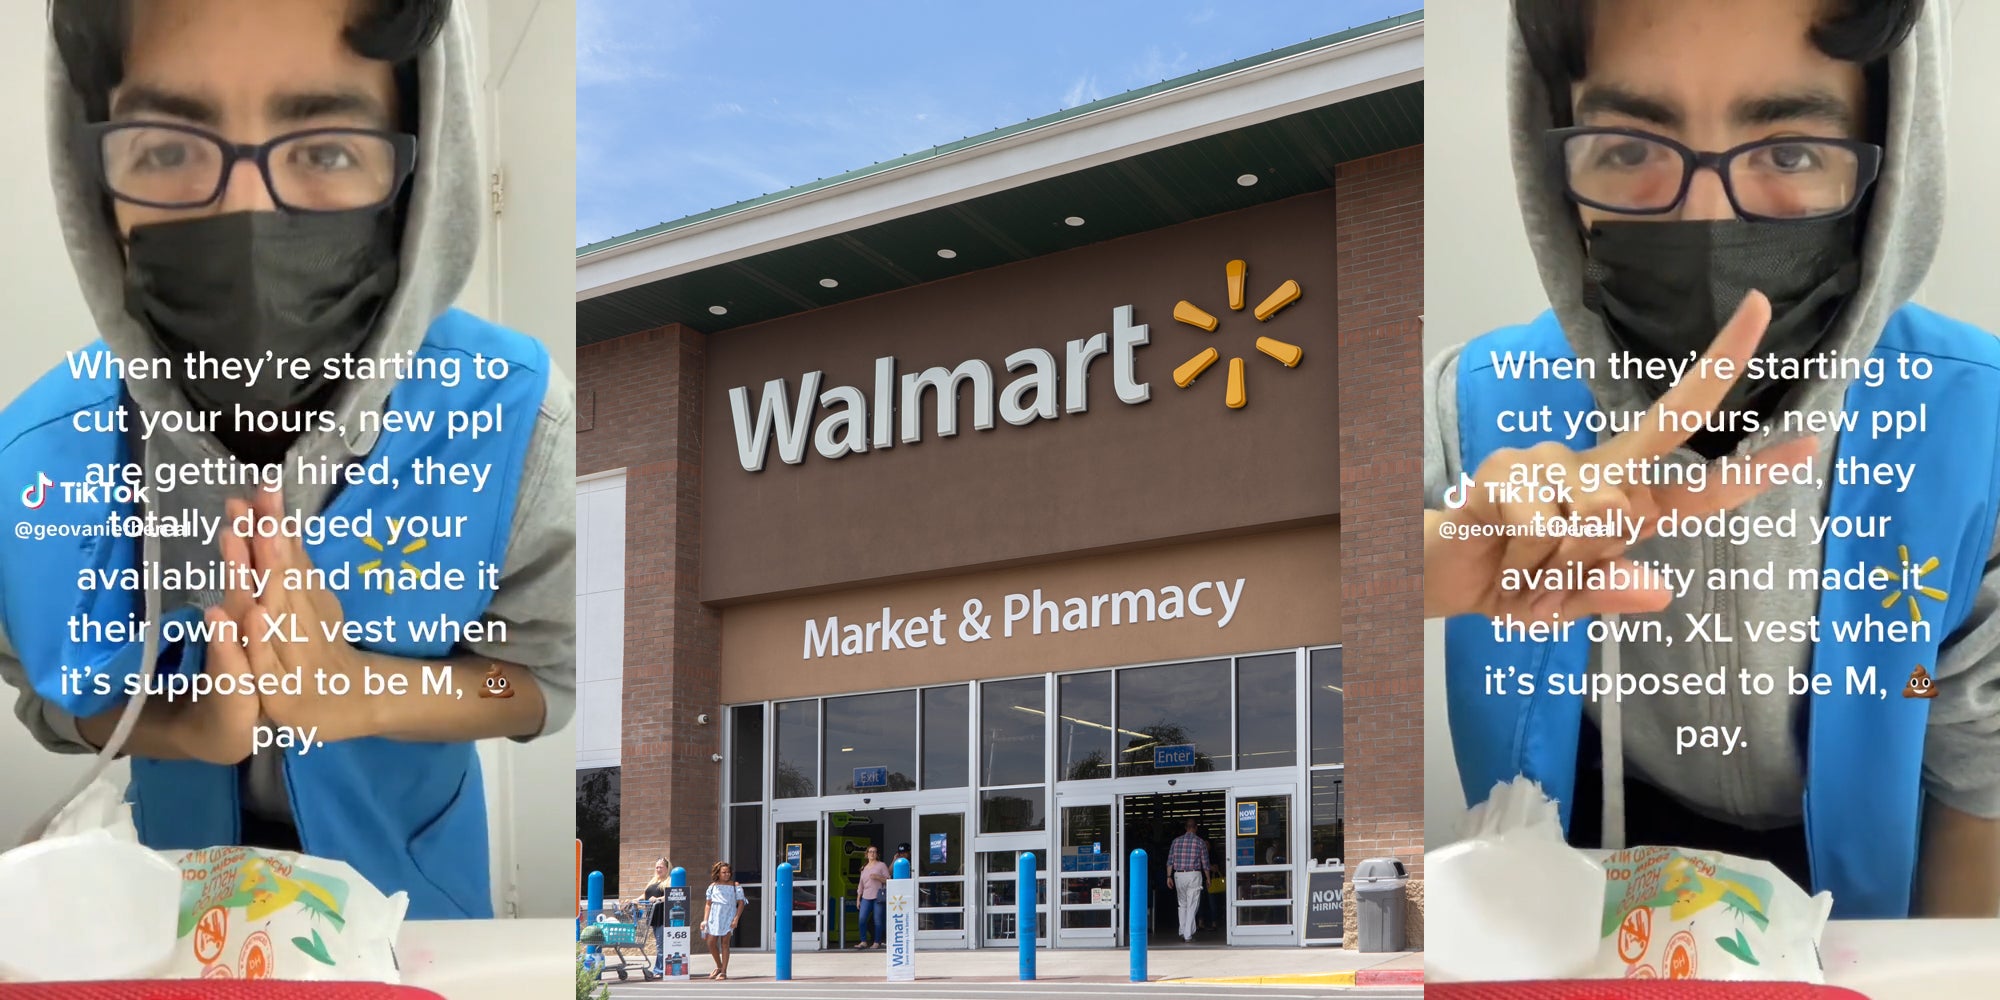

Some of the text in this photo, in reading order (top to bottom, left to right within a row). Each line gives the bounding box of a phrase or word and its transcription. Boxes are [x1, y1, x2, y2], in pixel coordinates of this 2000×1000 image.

[729, 304, 1150, 472] Walmart
[803, 578, 1245, 660] Market & Pharmacy
[1158, 750, 1190, 763] Enter
[861, 771, 880, 783] Exit
[1240, 809, 1256, 817] NOW
[892, 913, 904, 967] Walmart
